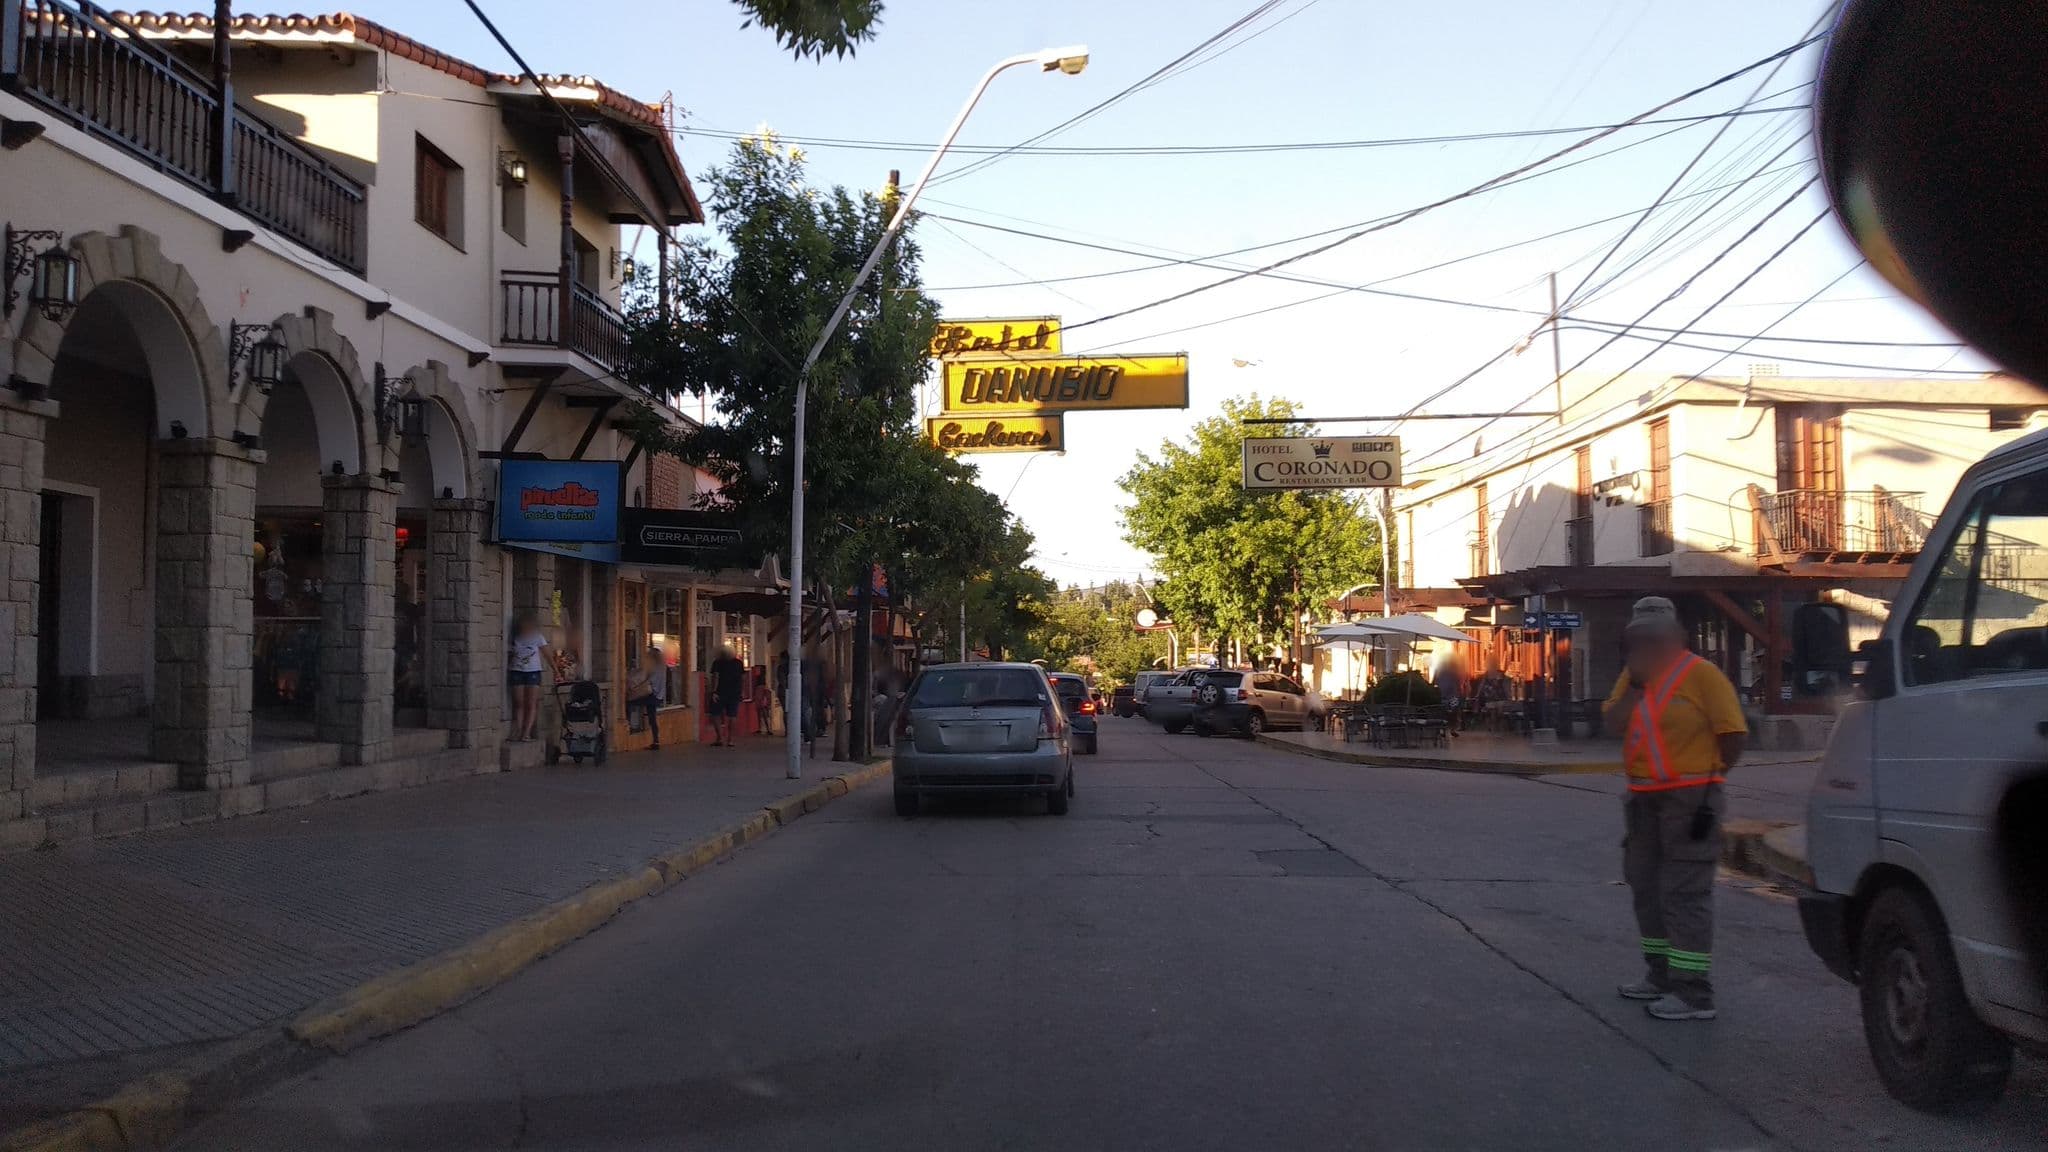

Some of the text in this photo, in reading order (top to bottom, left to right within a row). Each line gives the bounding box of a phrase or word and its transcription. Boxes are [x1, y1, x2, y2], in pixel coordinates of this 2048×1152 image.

[932, 324, 1051, 354] Hotel
[960, 365, 1125, 403] DANUBIO
[1252, 445, 1293, 454] HOTEL
[1254, 460, 1392, 482] CORONADO
[1280, 476, 1342, 484] RESTAURANTE
[646, 531, 690, 543] SIERRA
